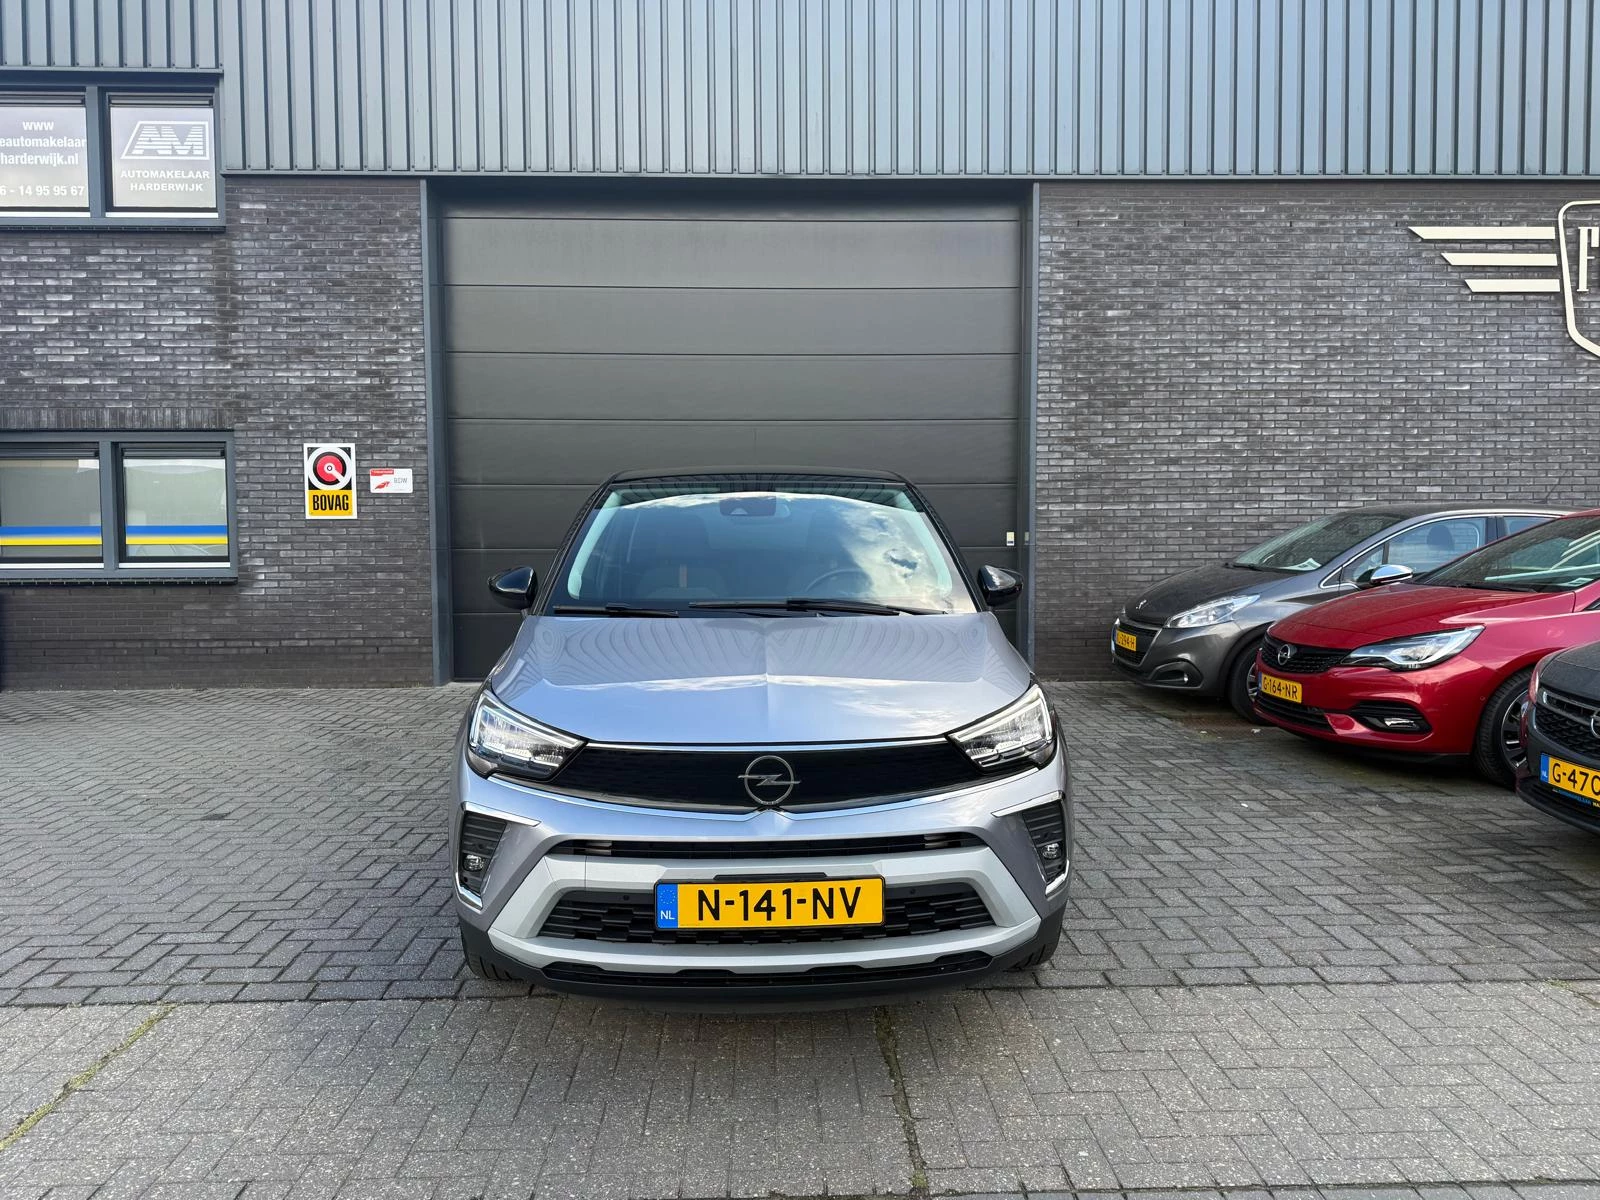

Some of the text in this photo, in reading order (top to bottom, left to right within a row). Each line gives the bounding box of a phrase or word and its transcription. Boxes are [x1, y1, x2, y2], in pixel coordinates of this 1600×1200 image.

[22, 120, 55, 131] www
[0, 152, 79, 167] harderwijk.nl
[120, 170, 210, 179] AUTOMAKELAAR
[18, 185, 33, 196] 14
[35, 185, 50, 196] 95
[53, 185, 67, 196] 95
[70, 185, 85, 196] 67
[130, 183, 204, 192] HARDERWIJK
[312, 494, 349, 511] BOVAG
[1263, 676, 1298, 700] G-164-NR
[660, 886, 862, 921] NL N-141-NV
